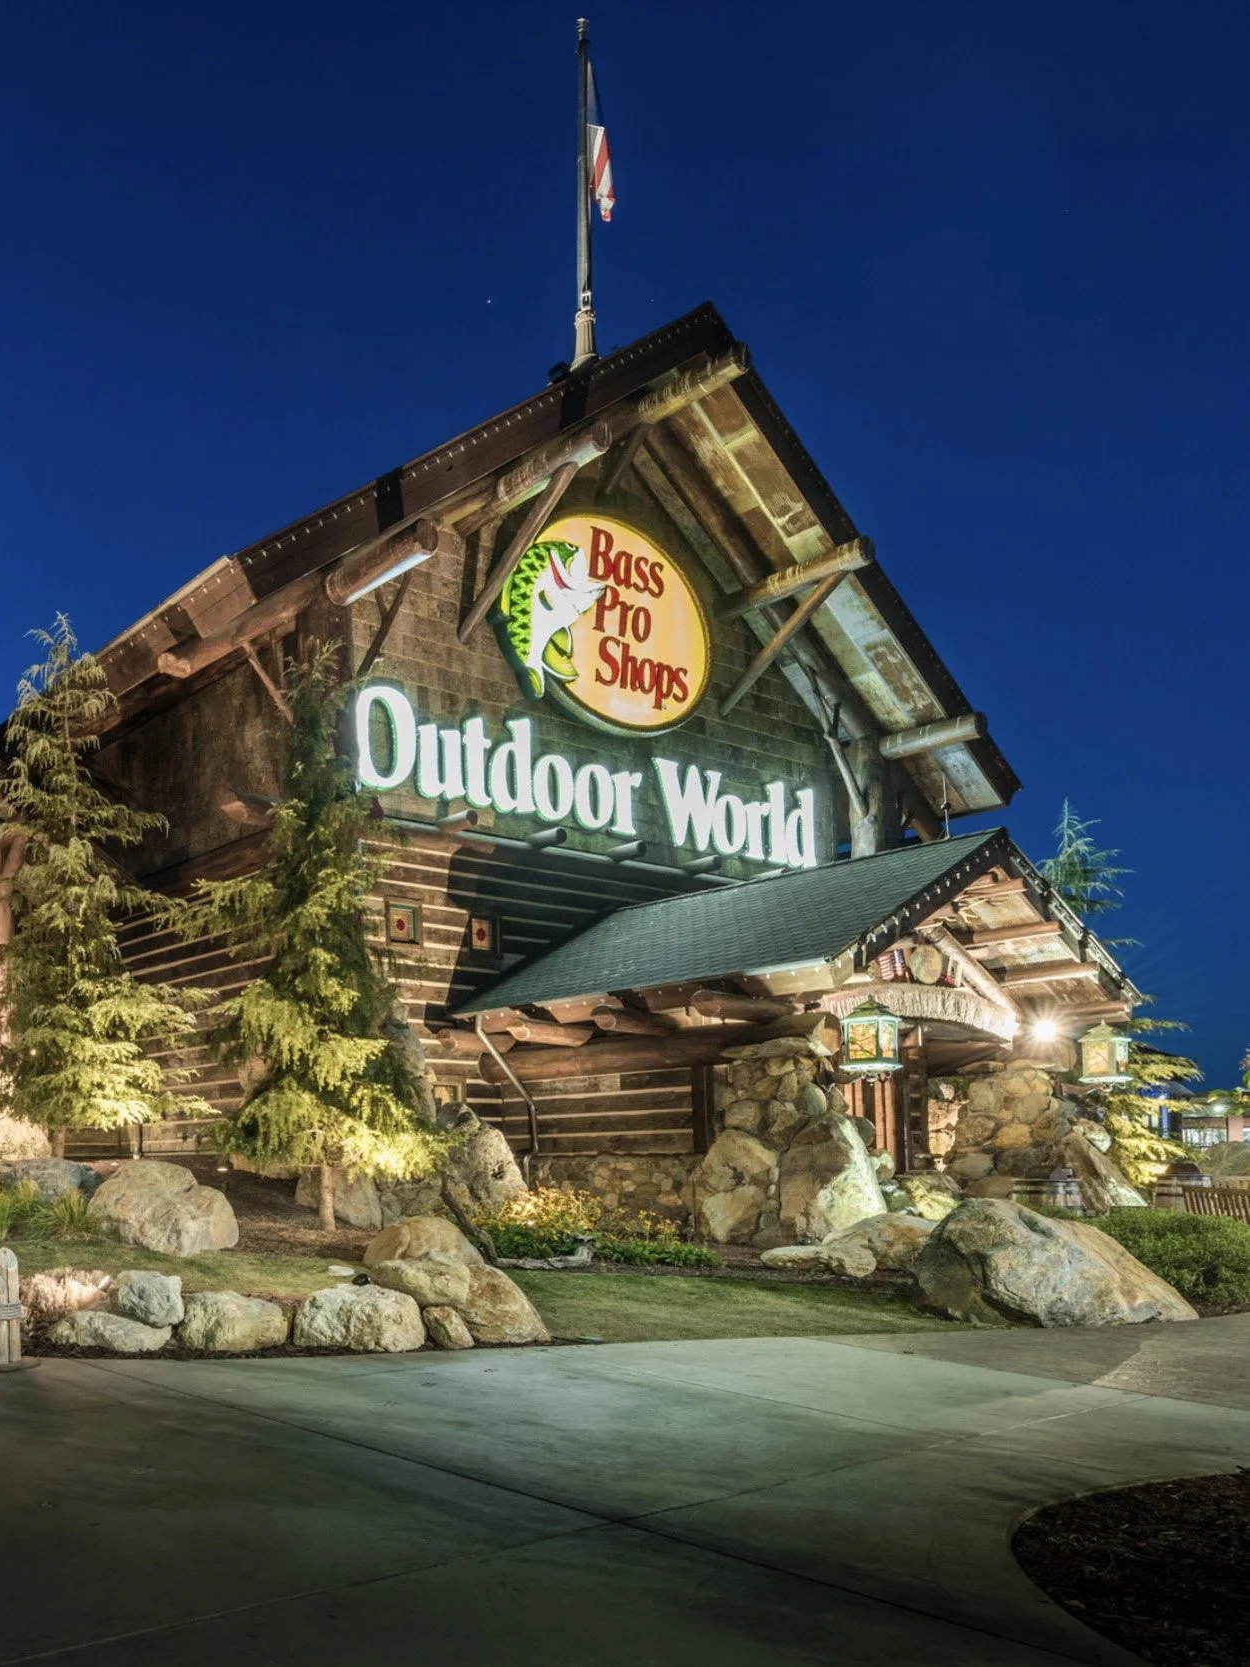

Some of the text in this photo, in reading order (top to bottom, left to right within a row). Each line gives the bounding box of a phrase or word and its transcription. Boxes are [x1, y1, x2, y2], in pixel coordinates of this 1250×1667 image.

[588, 526, 665, 599] Bass
[592, 585, 652, 643] Pro
[595, 635, 689, 710] Shops
[356, 685, 818, 868] Outdoor World
